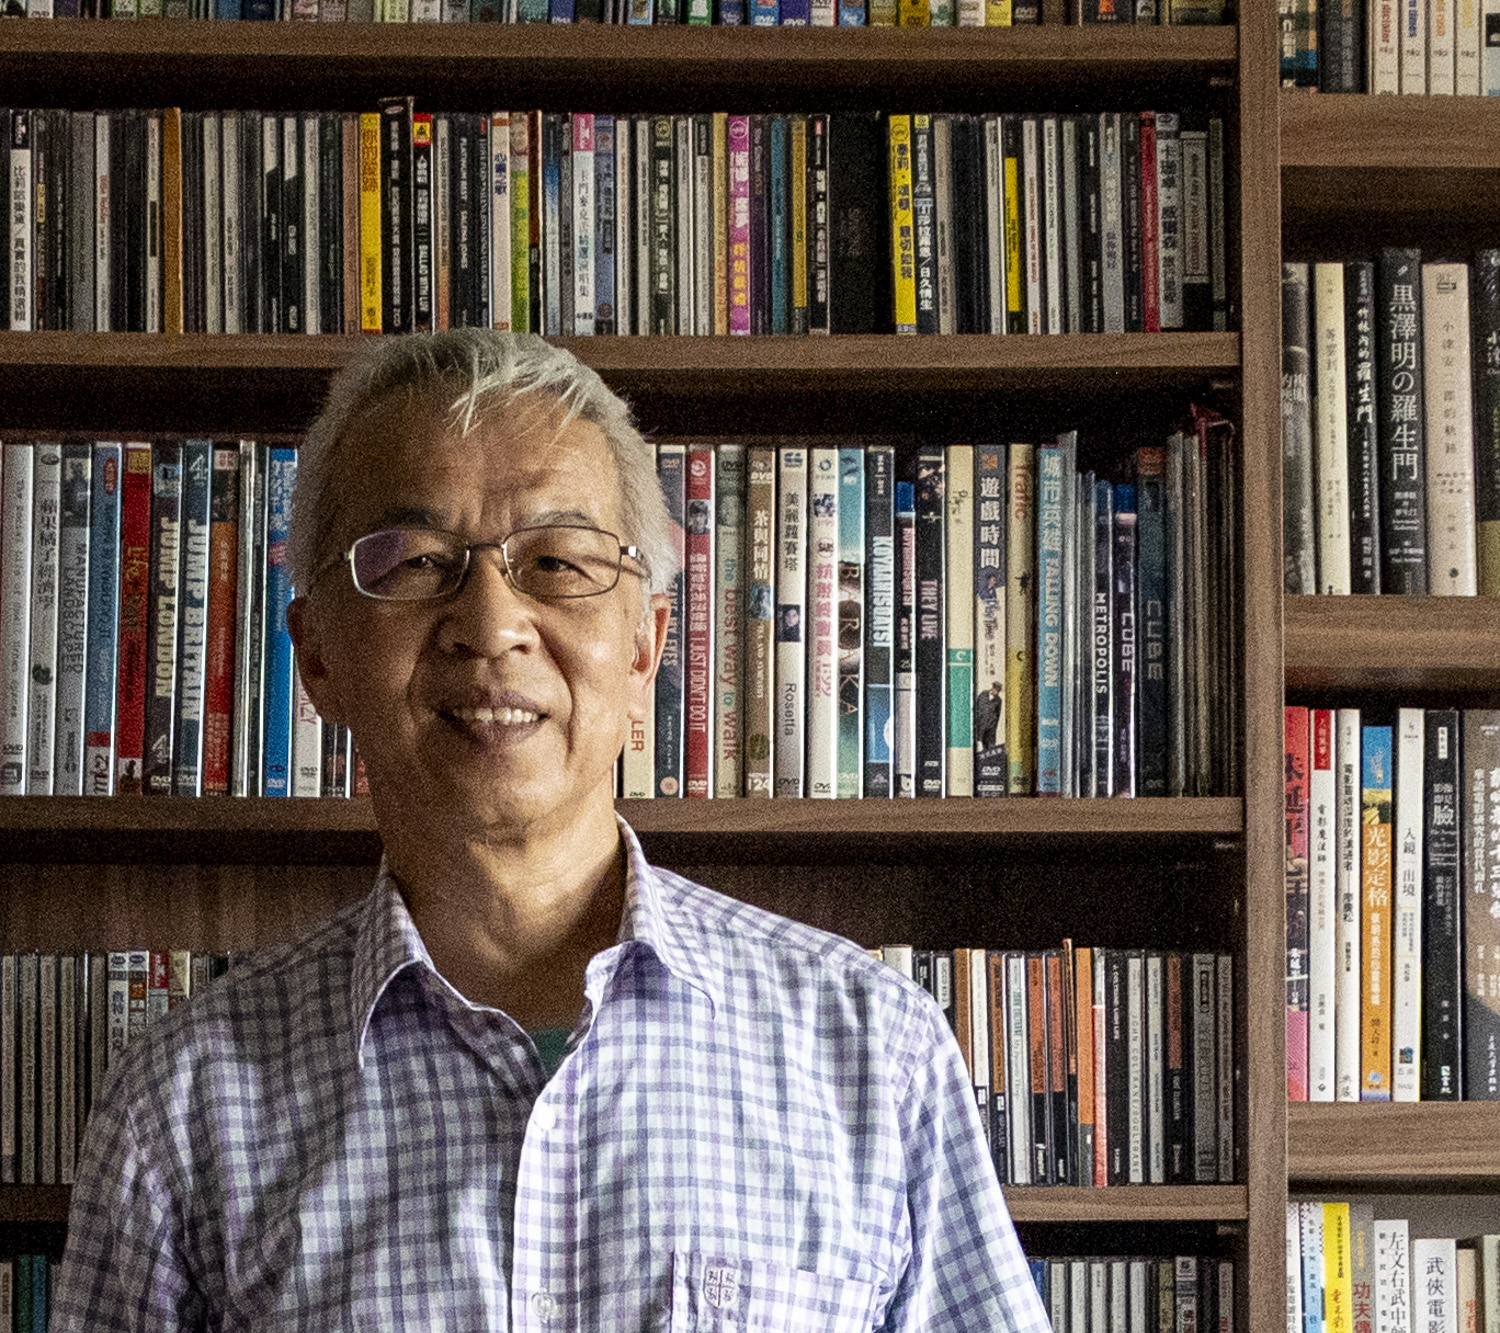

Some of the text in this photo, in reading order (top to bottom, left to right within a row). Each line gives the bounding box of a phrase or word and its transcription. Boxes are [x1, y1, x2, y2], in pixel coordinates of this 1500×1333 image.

[980, 477, 1000, 569] 遊戲時間
[155, 517, 177, 698] JUMP LONDON
[181, 519, 207, 721] JUMP BRITAIN
[921, 579, 938, 640] THEY LIVE
[1044, 557, 1061, 688] FALLING DOWN
[1096, 593, 1108, 695] METROPOLIS
[1121, 612, 1135, 673] CUBE
[1146, 600, 1163, 681] CUBE
[719, 558, 741, 761] the best way to walk
[785, 682, 797, 736] Rosetta
[1368, 826, 1388, 907] 光影定格
